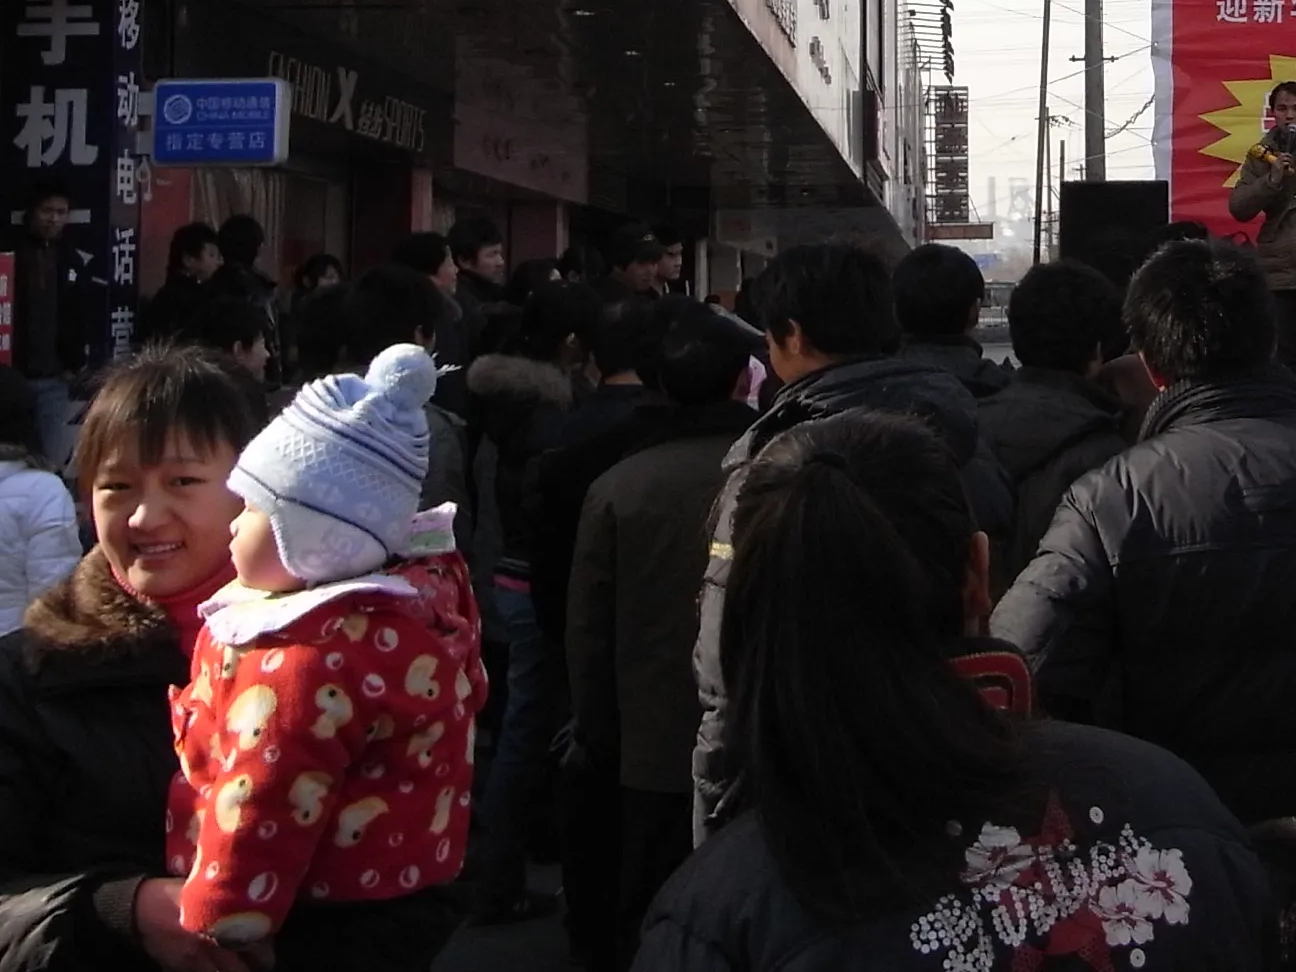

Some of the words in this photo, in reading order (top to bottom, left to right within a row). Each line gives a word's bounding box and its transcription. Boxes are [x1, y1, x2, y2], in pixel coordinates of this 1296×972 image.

[166, 131, 266, 152] 指定专营店
